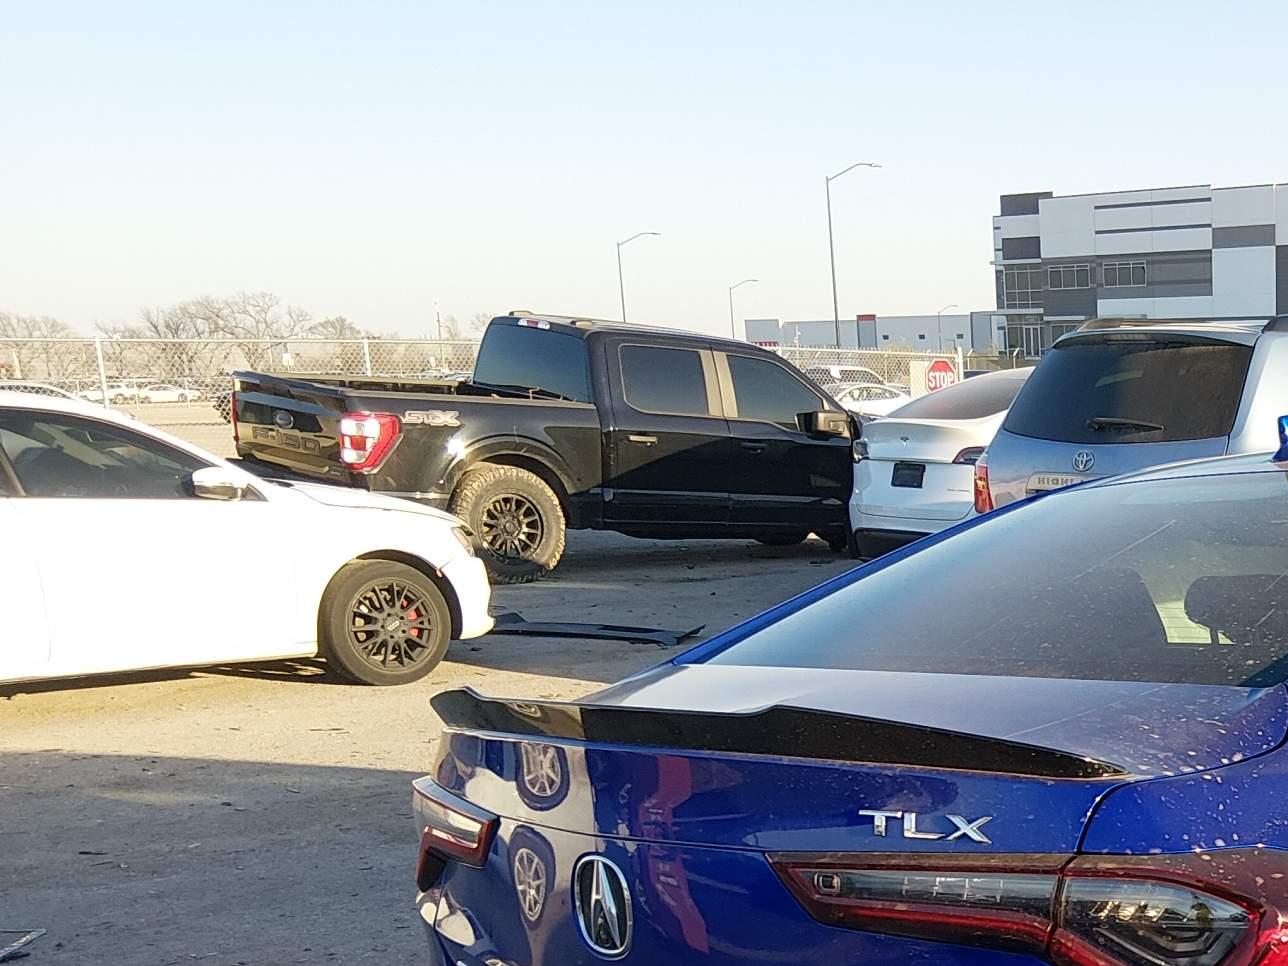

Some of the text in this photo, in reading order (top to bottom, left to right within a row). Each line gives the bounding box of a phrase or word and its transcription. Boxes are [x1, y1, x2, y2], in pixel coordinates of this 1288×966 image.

[928, 371, 955, 388] STOP
[252, 426, 320, 456] F-150
[858, 809, 993, 844] TLX
